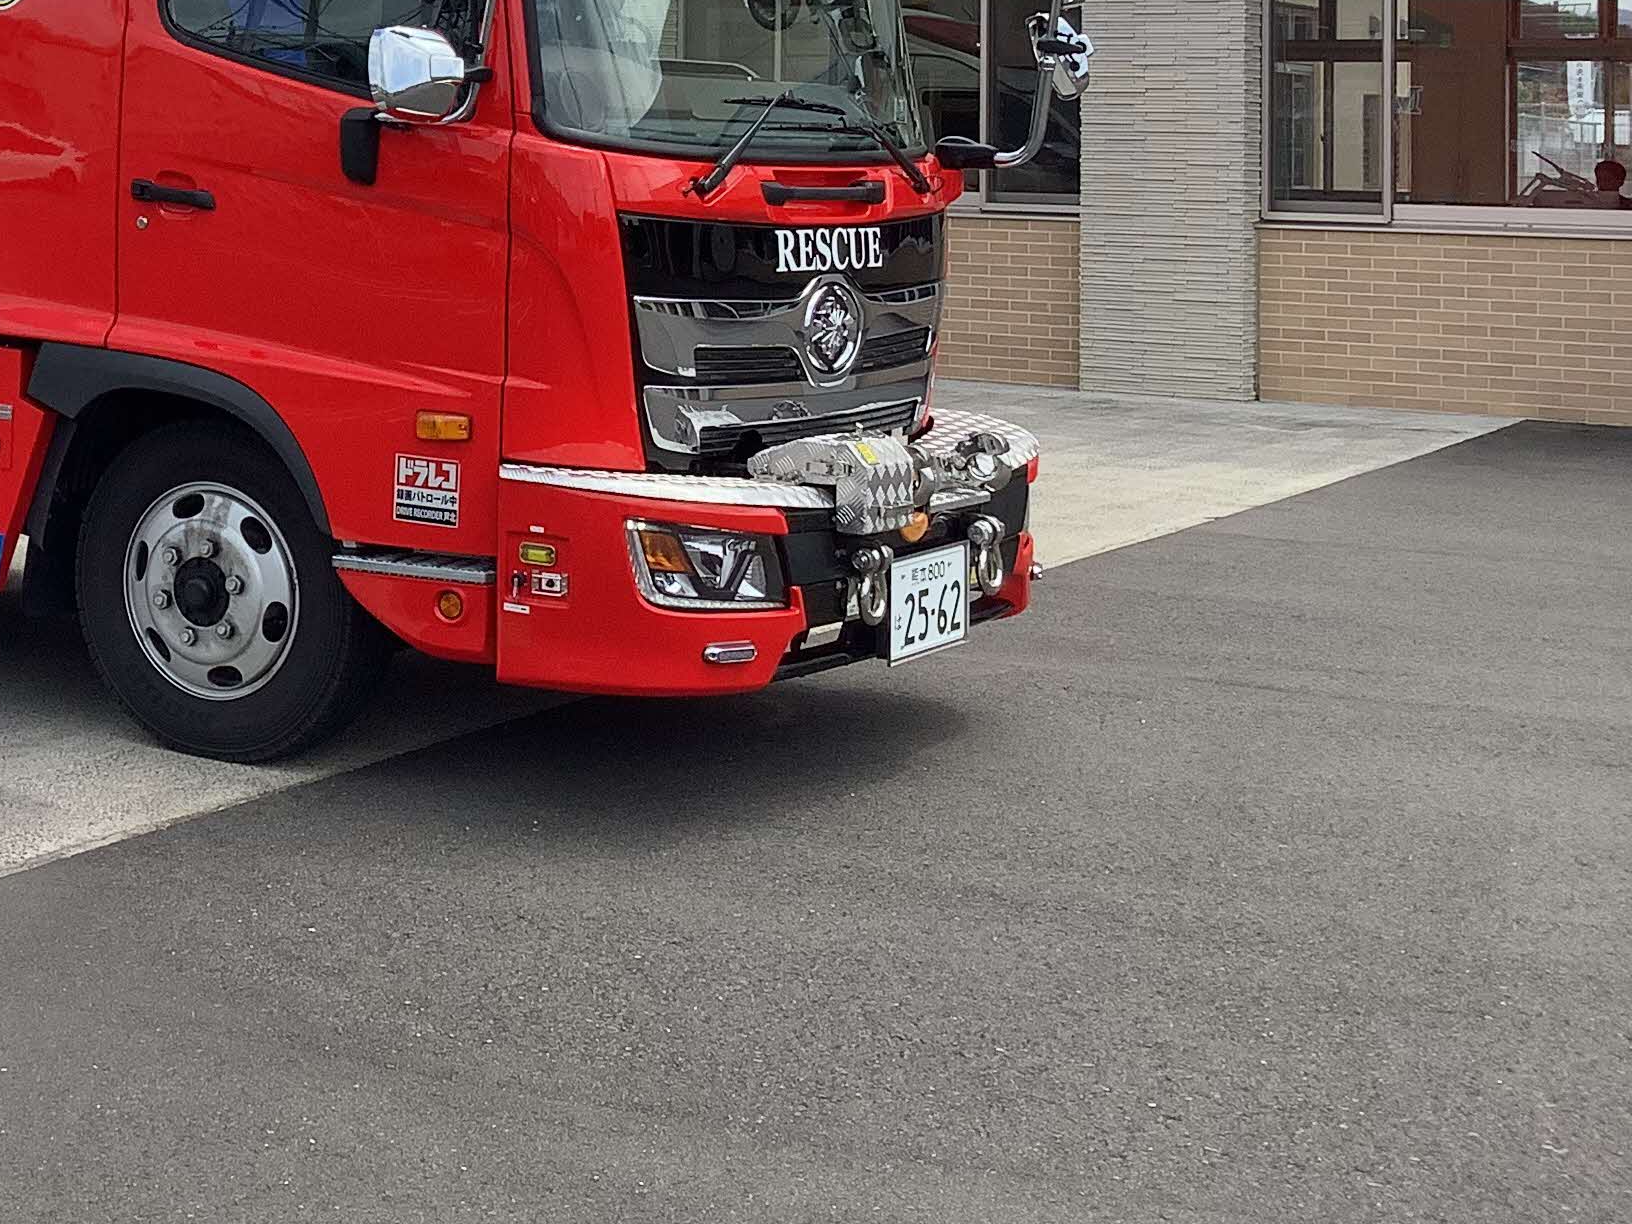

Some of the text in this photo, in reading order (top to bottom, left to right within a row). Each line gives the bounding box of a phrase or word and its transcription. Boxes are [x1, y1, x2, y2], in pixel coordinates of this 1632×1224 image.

[775, 227, 883, 272] RESCUE
[398, 457, 457, 490] ドラレコ
[413, 508, 443, 520] RECORDER
